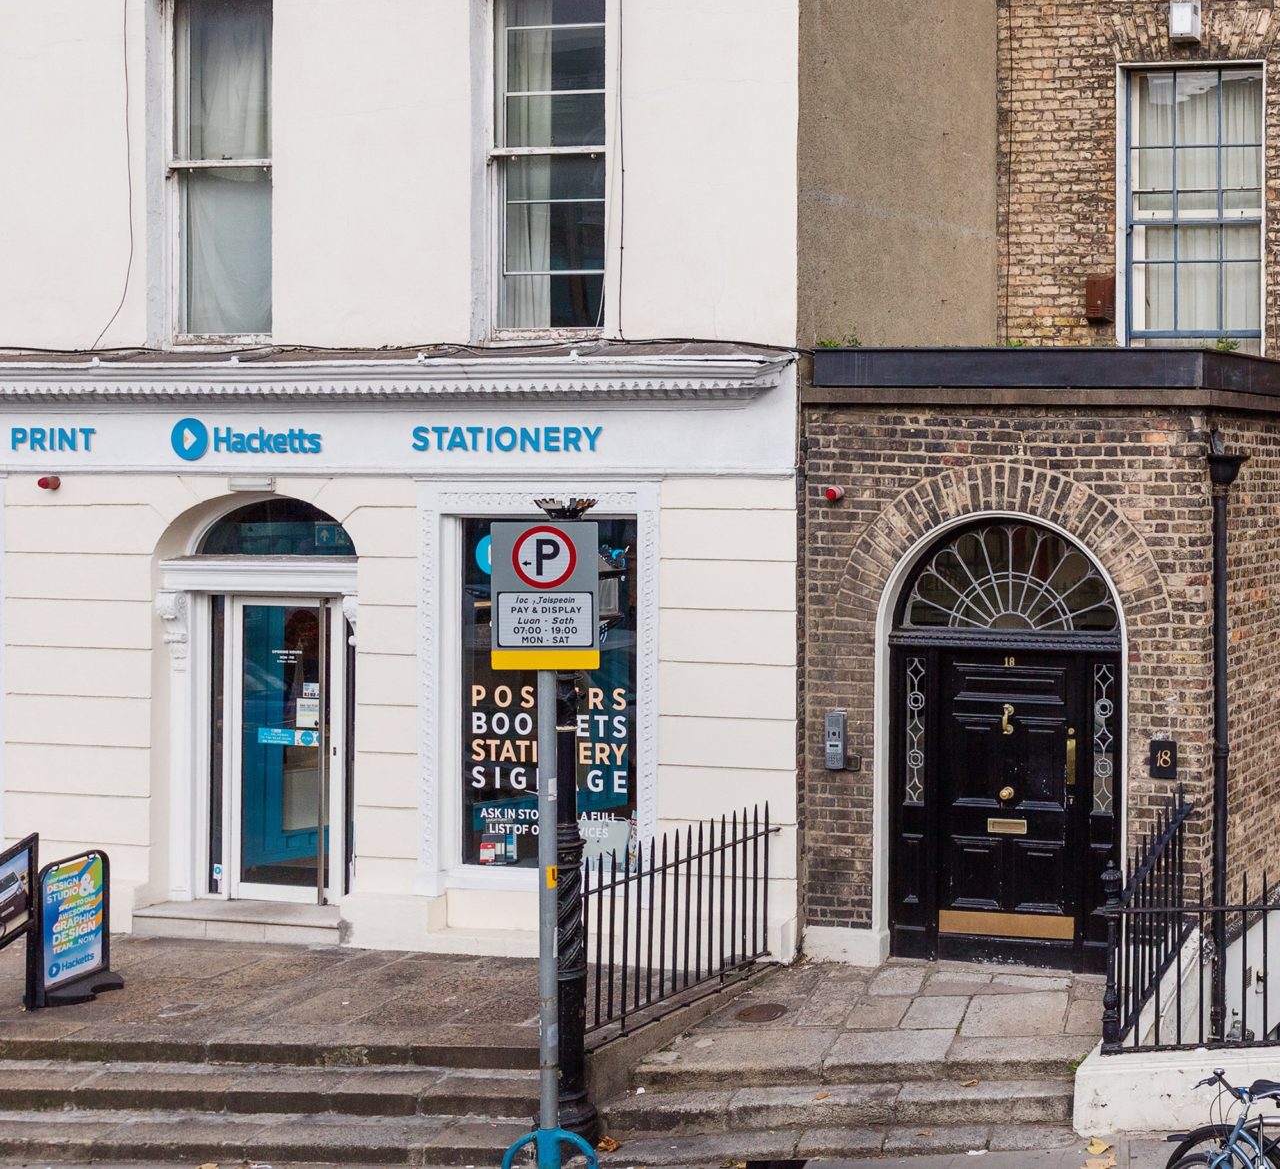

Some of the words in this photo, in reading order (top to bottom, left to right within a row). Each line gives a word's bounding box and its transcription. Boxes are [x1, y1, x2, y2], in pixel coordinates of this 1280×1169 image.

[11, 427, 96, 452] PRINT
[213, 426, 323, 454] Hacketts
[412, 426, 603, 453] STATIONERY
[536, 538, 561, 576] P
[511, 606, 529, 614] PAY
[532, 606, 538, 614] &
[541, 606, 582, 614] DISPLAY
[517, 616, 541, 625] Luan
[551, 616, 575, 625] Sath
[513, 626, 542, 635] 07:00
[551, 626, 578, 635] 19:00
[521, 636, 544, 644] MON
[552, 636, 570, 644] SAT
[1004, 656, 1015, 667] 18
[471, 684, 627, 711] POSRS
[471, 711, 627, 739] BOOETS
[471, 738, 628, 766] STATIERY
[1156, 750, 1171, 767] 18
[471, 765, 628, 794] SIGGE
[480, 807, 502, 819] ASK
[504, 808, 516, 820] IN
[517, 809, 539, 821] STO
[580, 812, 588, 822] A
[589, 811, 618, 823] FULL
[489, 823, 511, 834] LIST
[515, 824, 529, 835] OF
[47, 876, 79, 894] DESIGN
[79, 873, 95, 897] &
[47, 886, 79, 904] STUDIO
[52, 910, 96, 933] GRAPHIC
[52, 920, 96, 945] DESIGN
[62, 952, 95, 971] Hacketts
